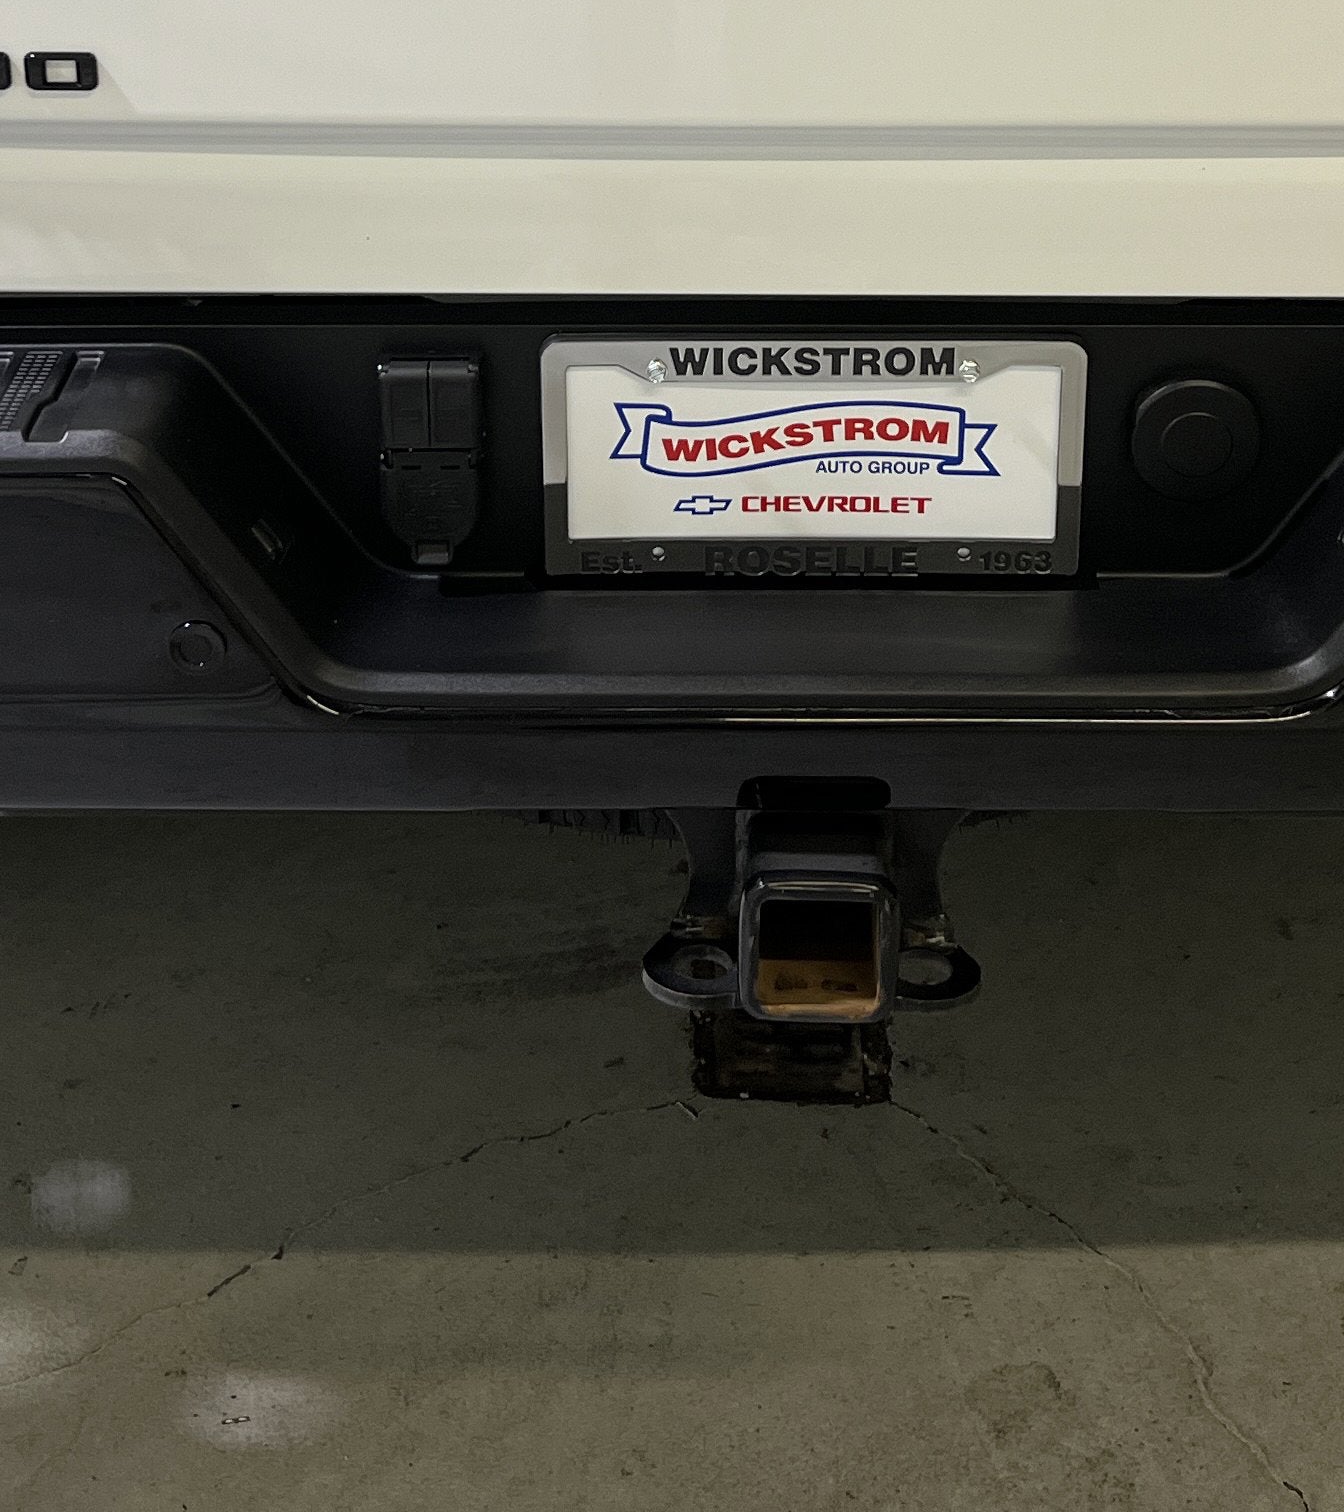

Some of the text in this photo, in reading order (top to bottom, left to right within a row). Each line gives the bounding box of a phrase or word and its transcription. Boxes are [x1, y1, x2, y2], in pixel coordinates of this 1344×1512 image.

[668, 346, 956, 377] WICKSTROM
[661, 418, 949, 462] WICKSTROM
[815, 460, 930, 475] AUTO GROUP
[741, 495, 932, 514] CHEVROLET
[580, 544, 1053, 577] Est. ROSELLE 1963
